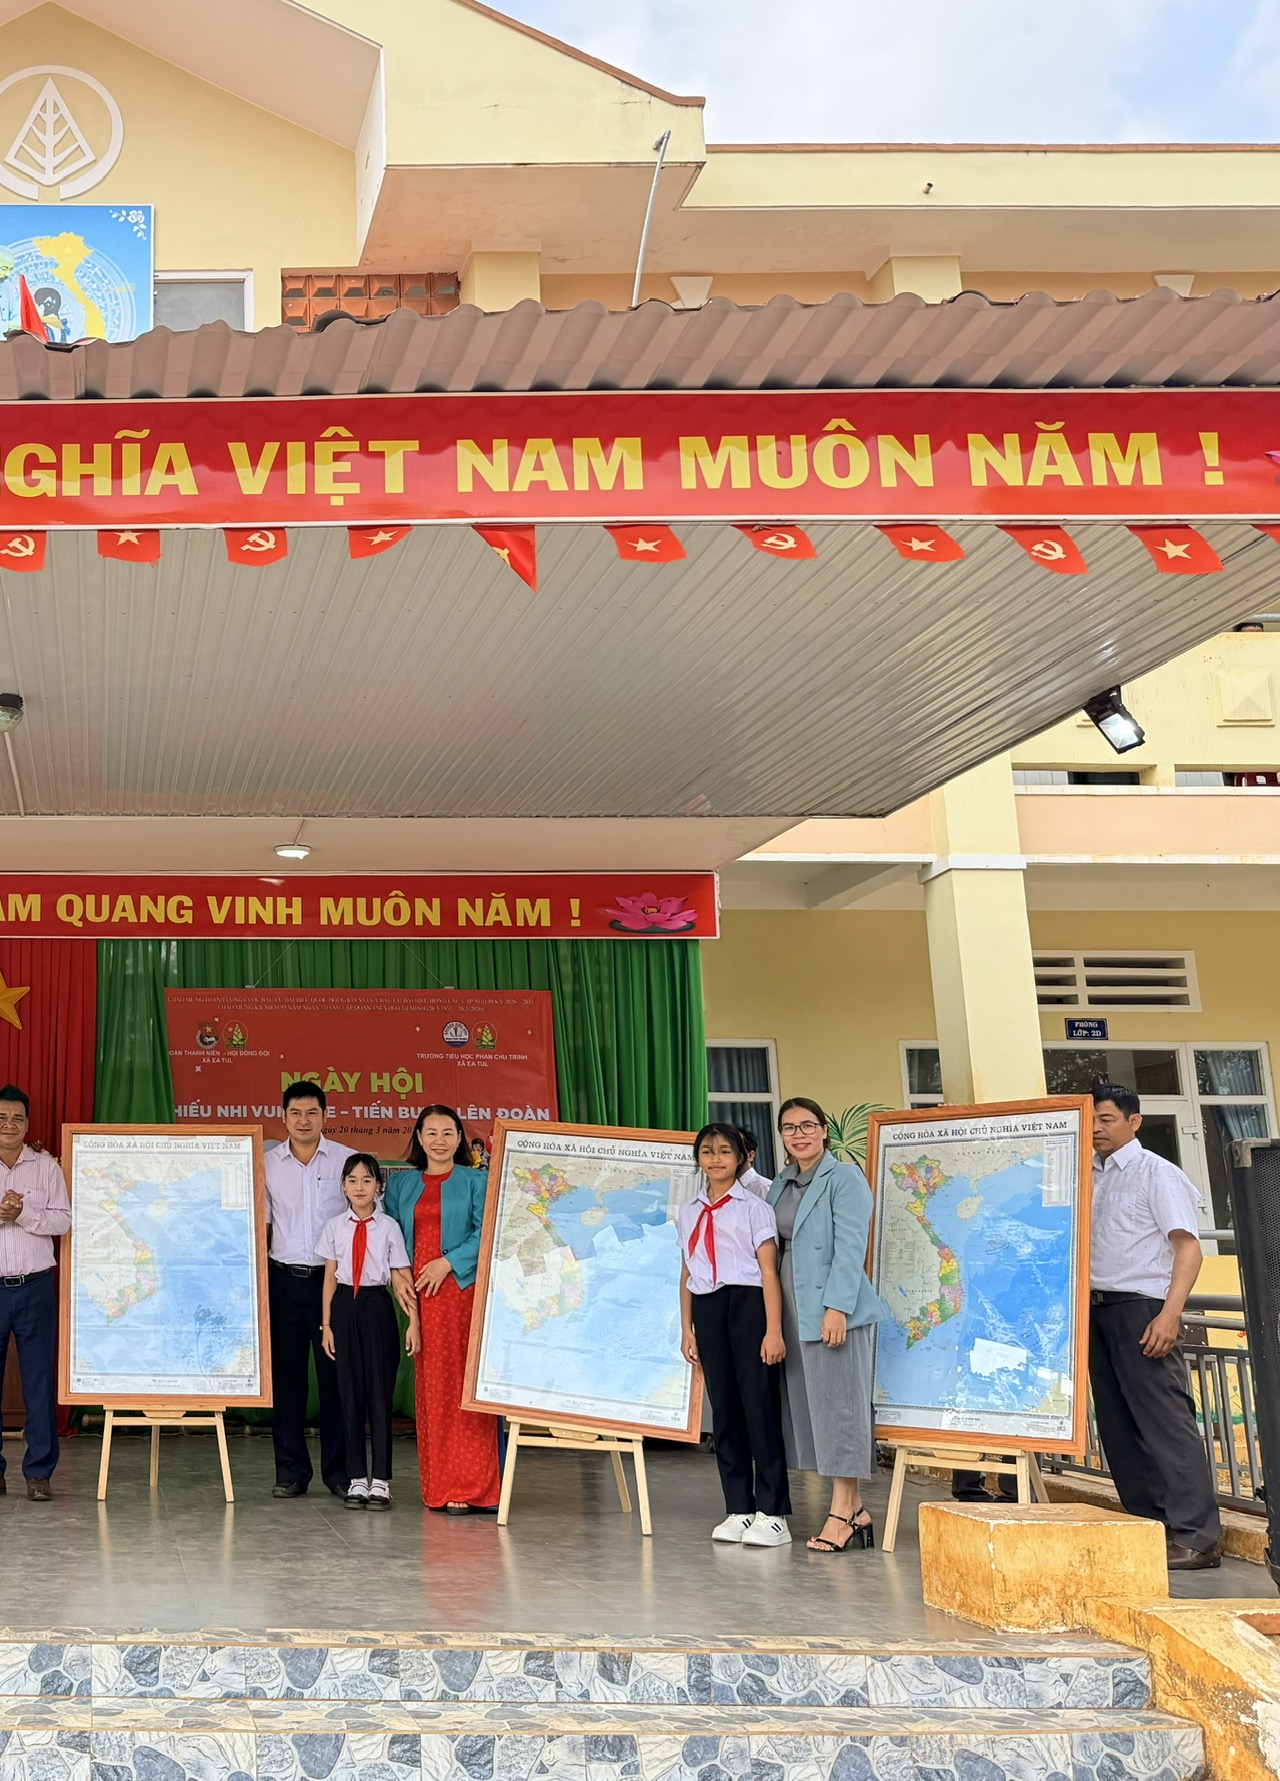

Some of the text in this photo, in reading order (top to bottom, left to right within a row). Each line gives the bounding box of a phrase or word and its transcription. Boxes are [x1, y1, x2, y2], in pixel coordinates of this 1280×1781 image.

[228, 426, 420, 506] VIỆT
[456, 437, 644, 492] NAM
[679, 418, 934, 490] MUÔN
[968, 421, 1163, 487] NĂM
[1199, 432, 1225, 486] !
[56, 893, 193, 927] QUANG
[206, 895, 302, 925] VINH
[320, 890, 441, 926] MUÔN
[457, 892, 551, 927] NĂM
[570, 898, 581, 927] !
[370, 1066, 423, 1100] HỘI
[174, 1099, 212, 1118] HIẾU
[217, 1105, 248, 1118] NHI
[351, 1100, 393, 1119] TIẾN
[456, 1104, 491, 1120] LÊN
[496, 1105, 550, 1121] ĐOÀN
[339, 1125, 349, 1134] 20
[1045, 1121, 1068, 1130] NAM
[674, 1153, 696, 1161] NAM
